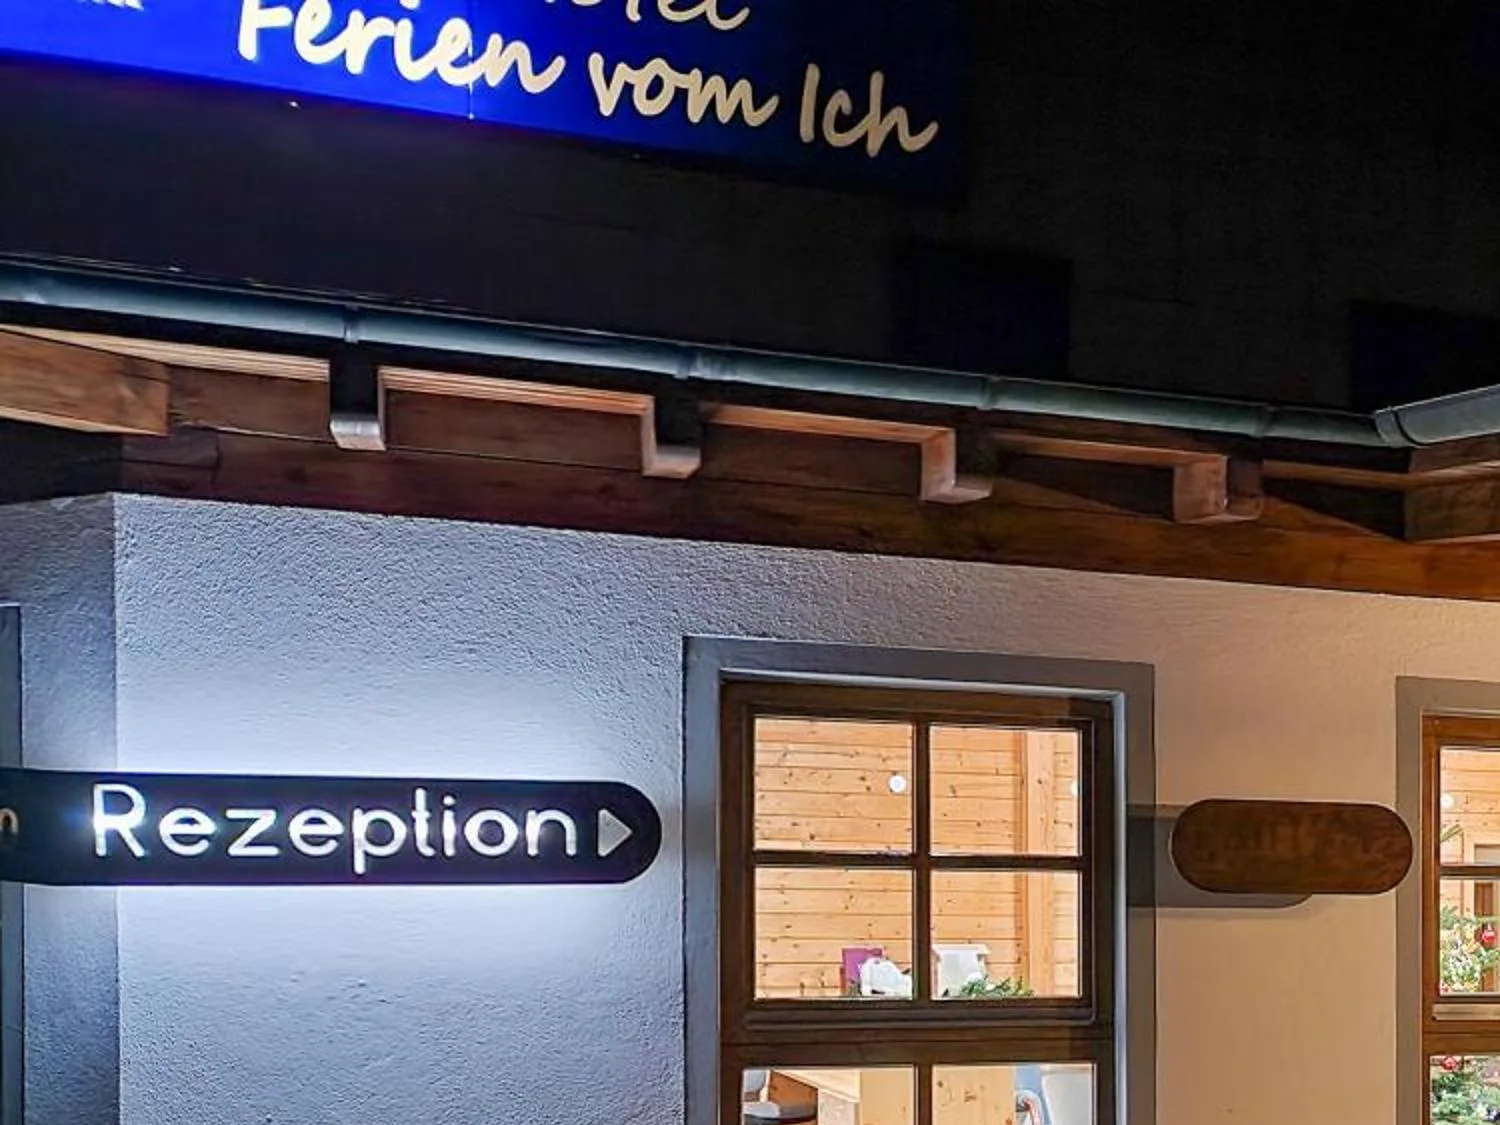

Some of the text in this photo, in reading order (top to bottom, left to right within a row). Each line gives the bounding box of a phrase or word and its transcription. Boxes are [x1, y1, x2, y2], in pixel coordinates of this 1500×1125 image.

[238, 0, 938, 158] Ferien vom Ich
[92, 784, 578, 874] Rezeption
